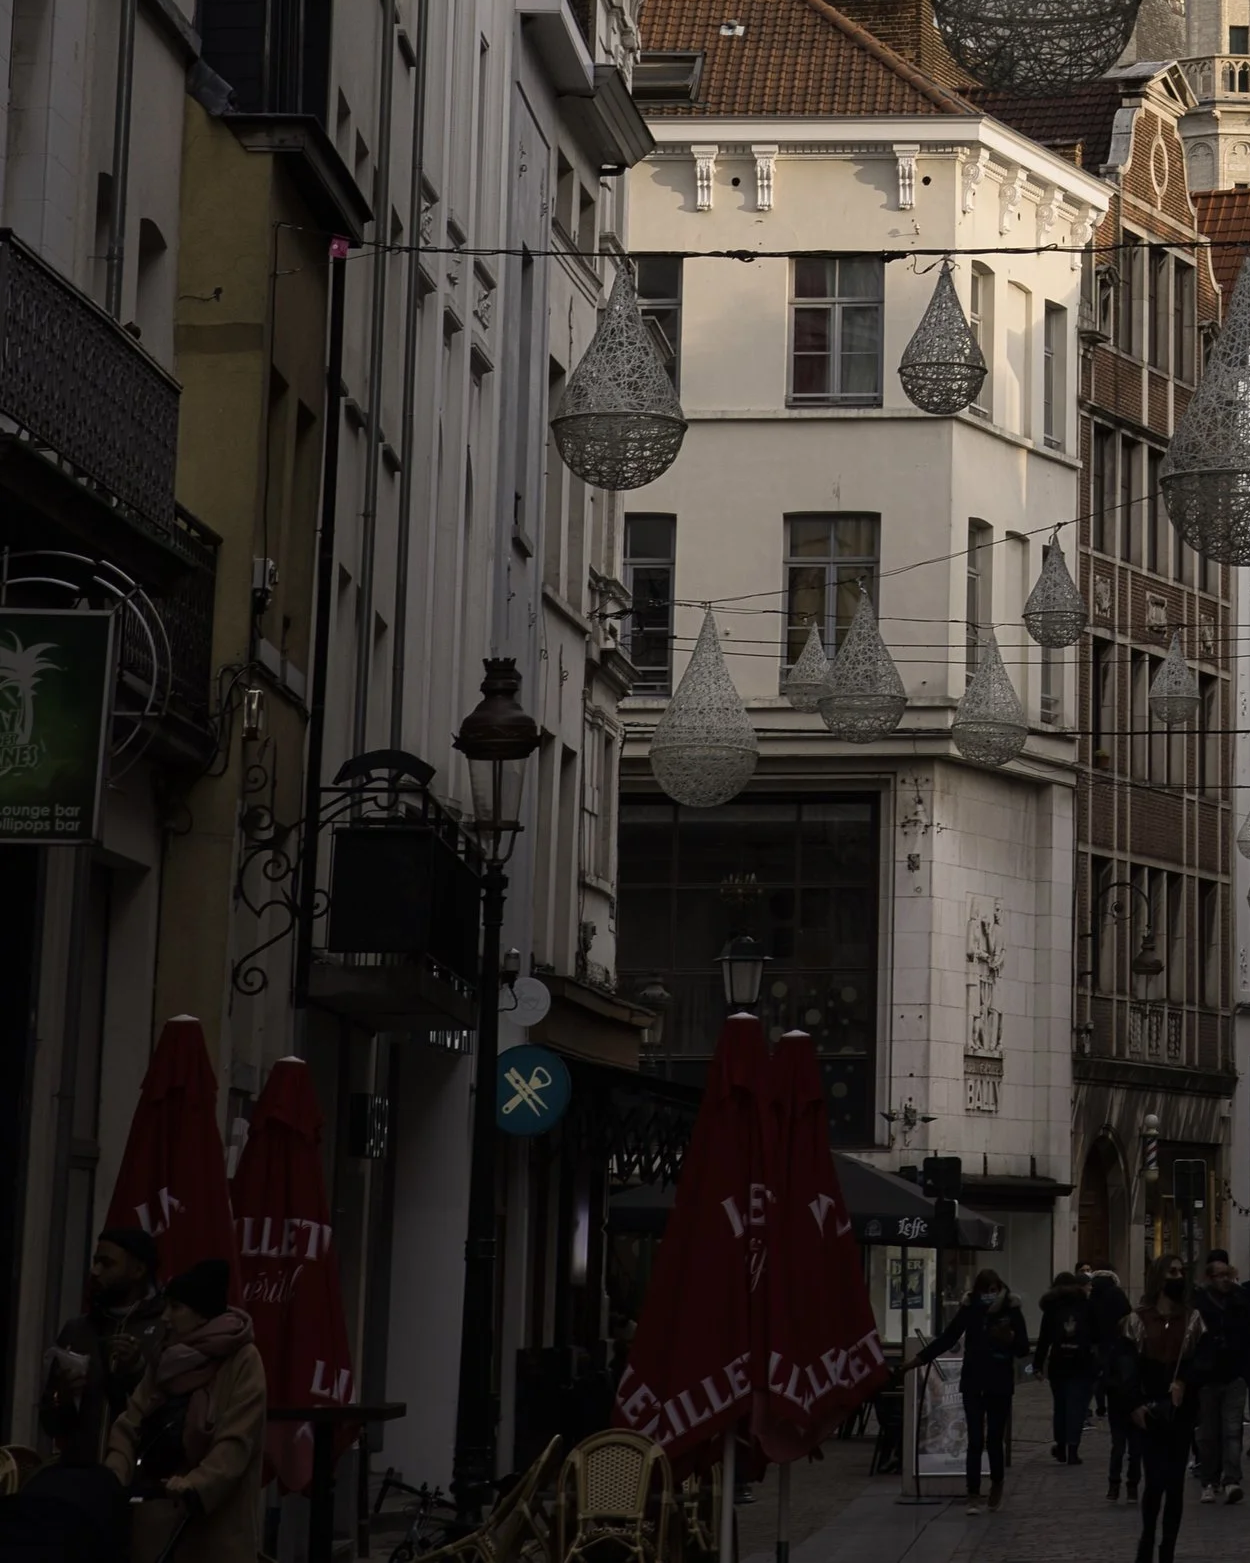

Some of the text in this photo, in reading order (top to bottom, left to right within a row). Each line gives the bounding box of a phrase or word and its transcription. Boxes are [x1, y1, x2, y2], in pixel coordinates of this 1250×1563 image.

[54, 803, 81, 817] bar
[54, 818, 81, 832] bar
[897, 1216, 929, 1240] Leffe
